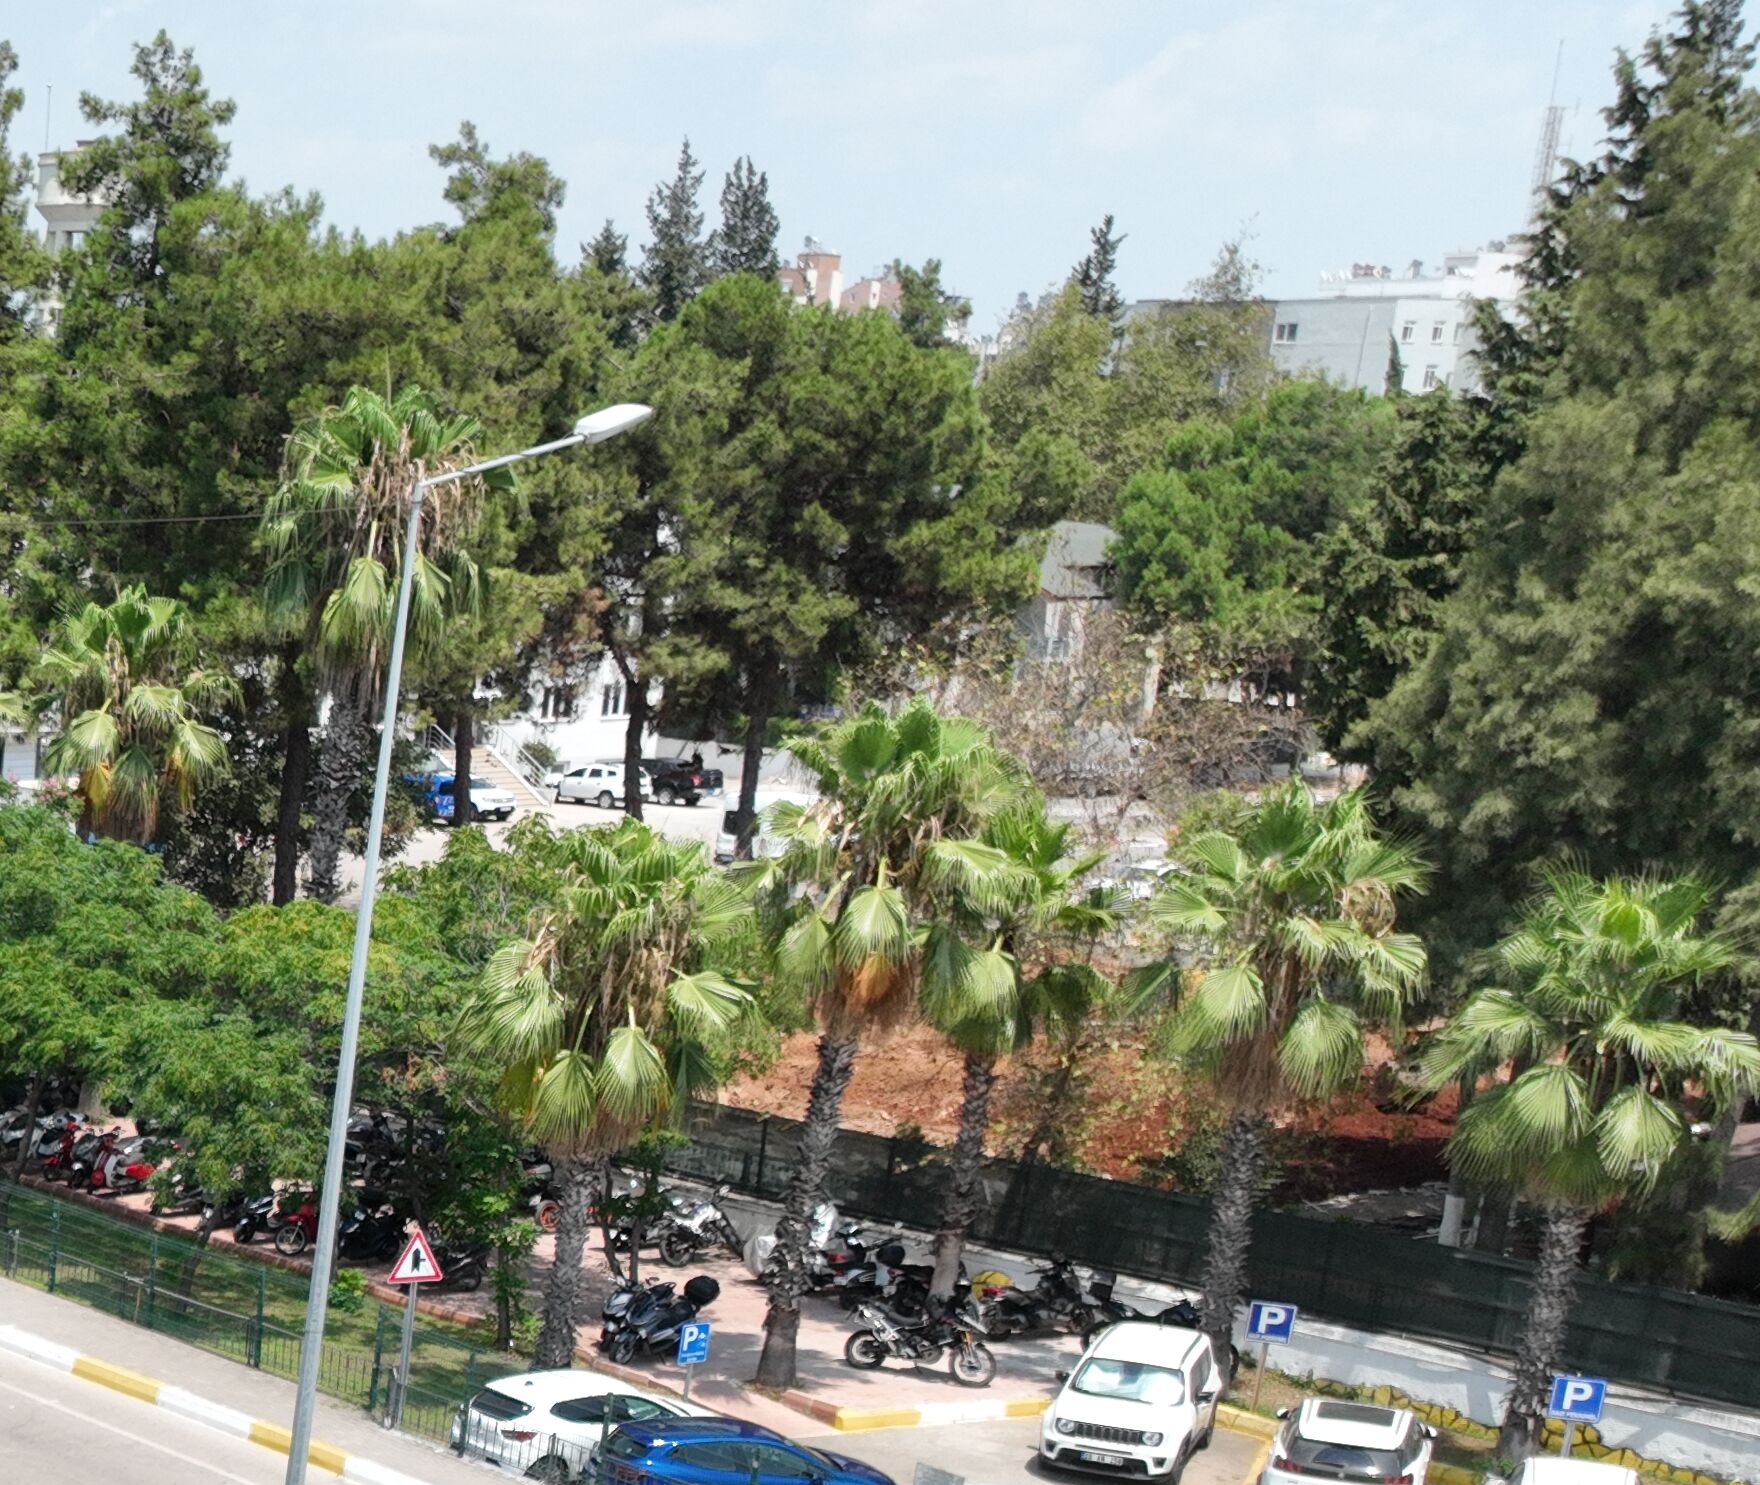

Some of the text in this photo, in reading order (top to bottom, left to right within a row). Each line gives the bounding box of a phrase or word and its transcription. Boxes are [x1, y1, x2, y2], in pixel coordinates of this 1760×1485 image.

[1258, 1306, 1286, 1334] P
[683, 1326, 699, 1351] P
[1562, 1381, 1593, 1410] P
